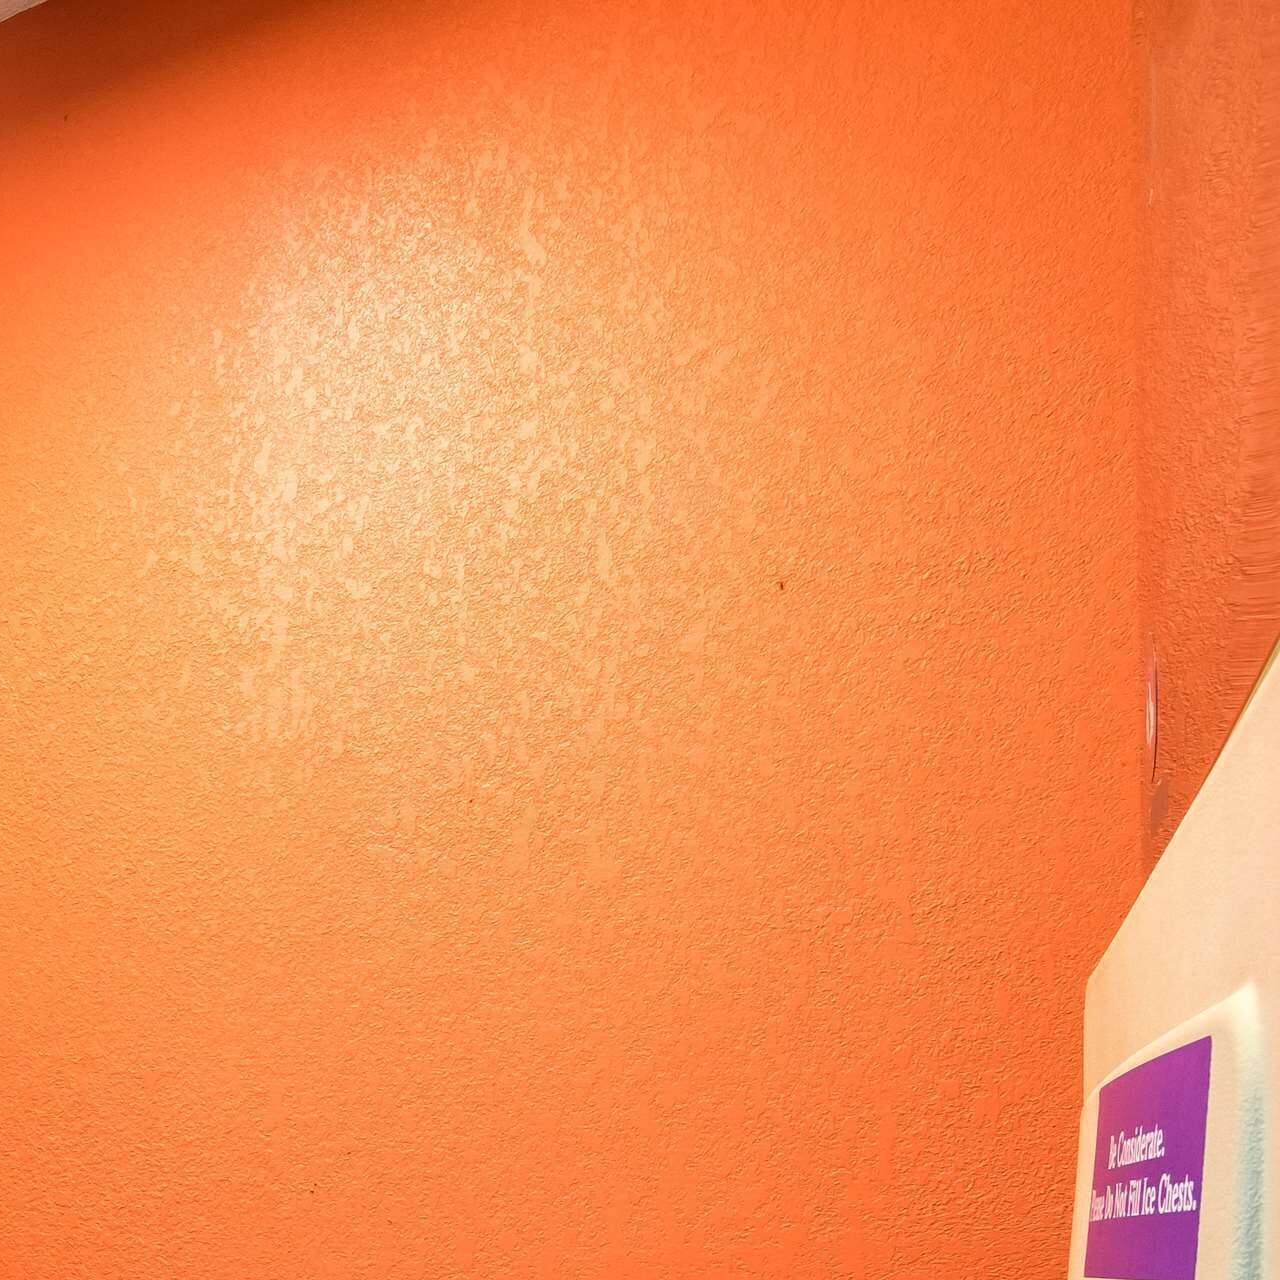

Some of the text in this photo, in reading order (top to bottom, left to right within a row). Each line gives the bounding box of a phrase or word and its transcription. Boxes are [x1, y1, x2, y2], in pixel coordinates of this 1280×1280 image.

[1108, 1124, 1166, 1170] Be Considerate.
[1104, 1190, 1114, 1220] Do
[1114, 1183, 1127, 1218] Not
[1128, 1177, 1141, 1216] Fill
[1141, 1177, 1156, 1216] Ice
[1158, 1173, 1197, 1215] Chests.
